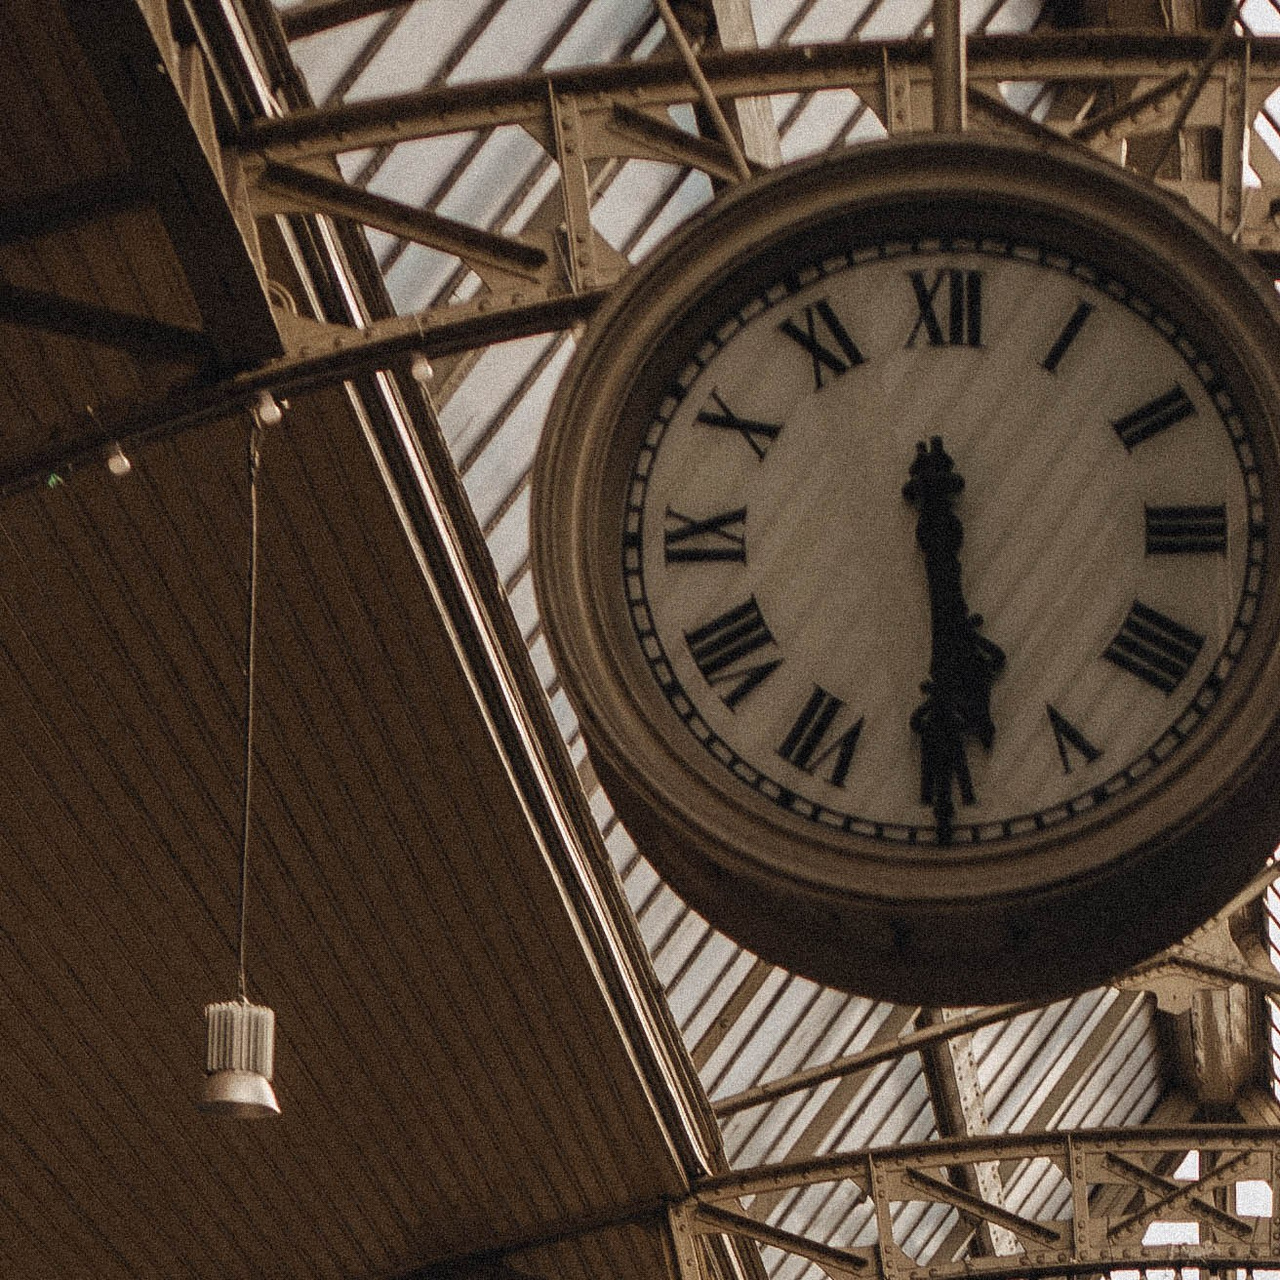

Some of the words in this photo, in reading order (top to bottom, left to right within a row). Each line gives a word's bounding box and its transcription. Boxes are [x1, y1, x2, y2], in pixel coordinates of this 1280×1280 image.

[907, 269, 986, 347] XII
[1042, 302, 1095, 371] I
[779, 299, 865, 391] XI
[696, 391, 782, 461] X
[1113, 382, 1196, 451] II
[664, 506, 748, 566] IX
[1145, 502, 1229, 556] III
[683, 595, 782, 711] VIII
[1103, 600, 1206, 693] IIII
[777, 685, 866, 788] VII
[1047, 703, 1104, 774] V
